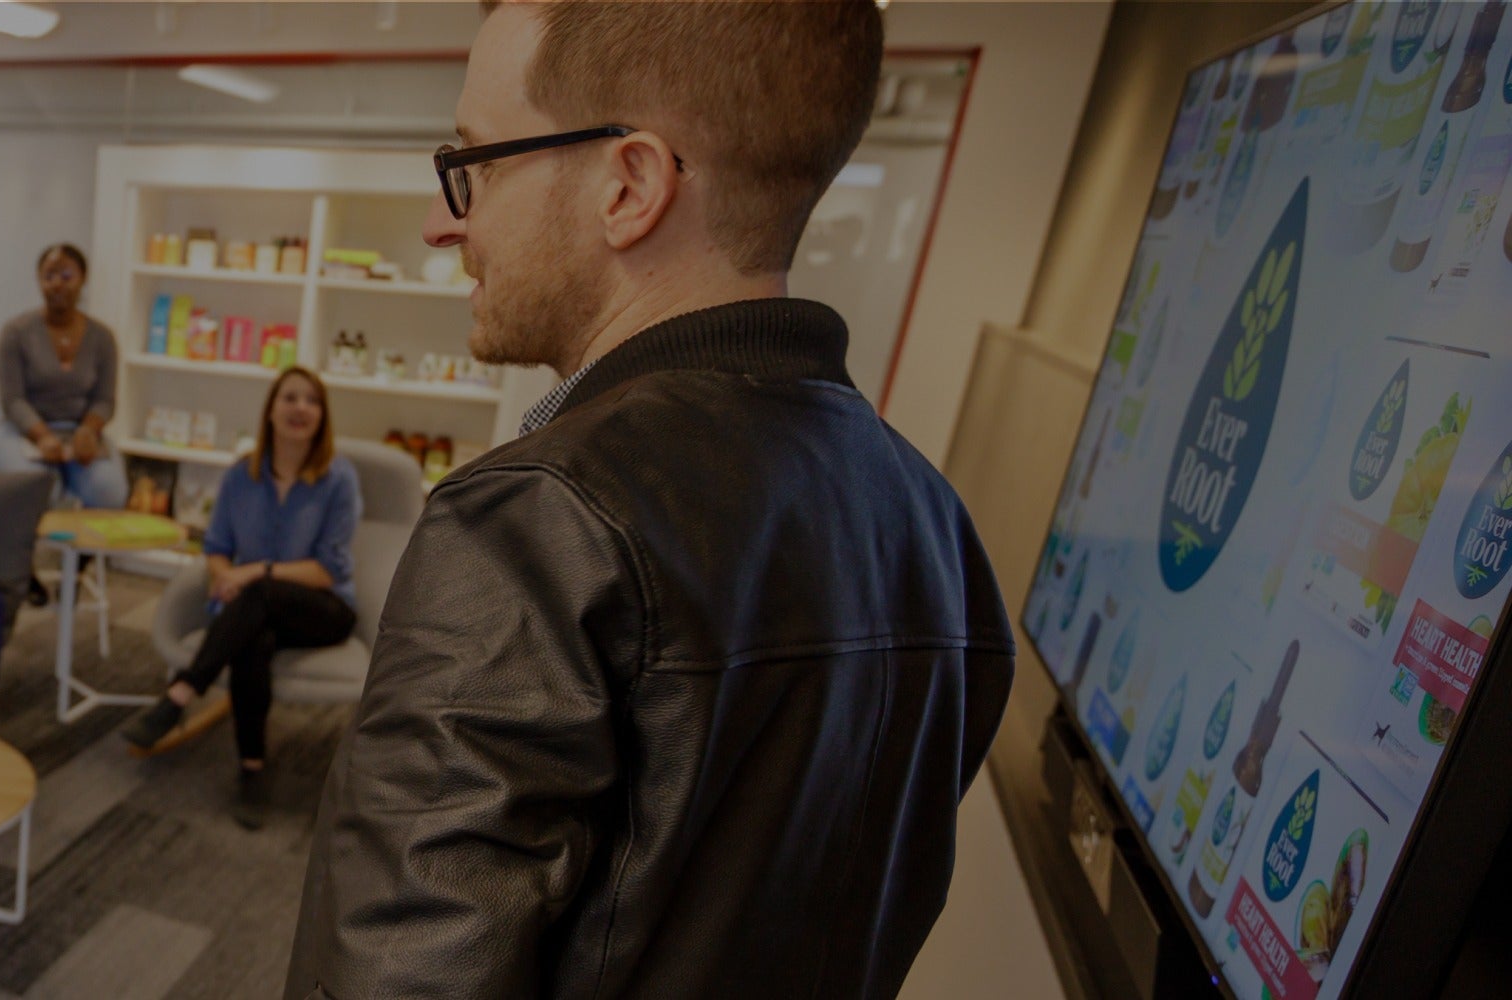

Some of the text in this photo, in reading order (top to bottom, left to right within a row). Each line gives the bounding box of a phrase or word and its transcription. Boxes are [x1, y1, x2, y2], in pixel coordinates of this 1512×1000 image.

[1197, 396, 1248, 462] Ever
[1478, 504, 1512, 539] Ever
[1411, 615, 1446, 655] HEART
[1439, 636, 1484, 679] HEALTH
[1238, 891, 1266, 937] HEART
[1258, 922, 1290, 977] HEALTH
